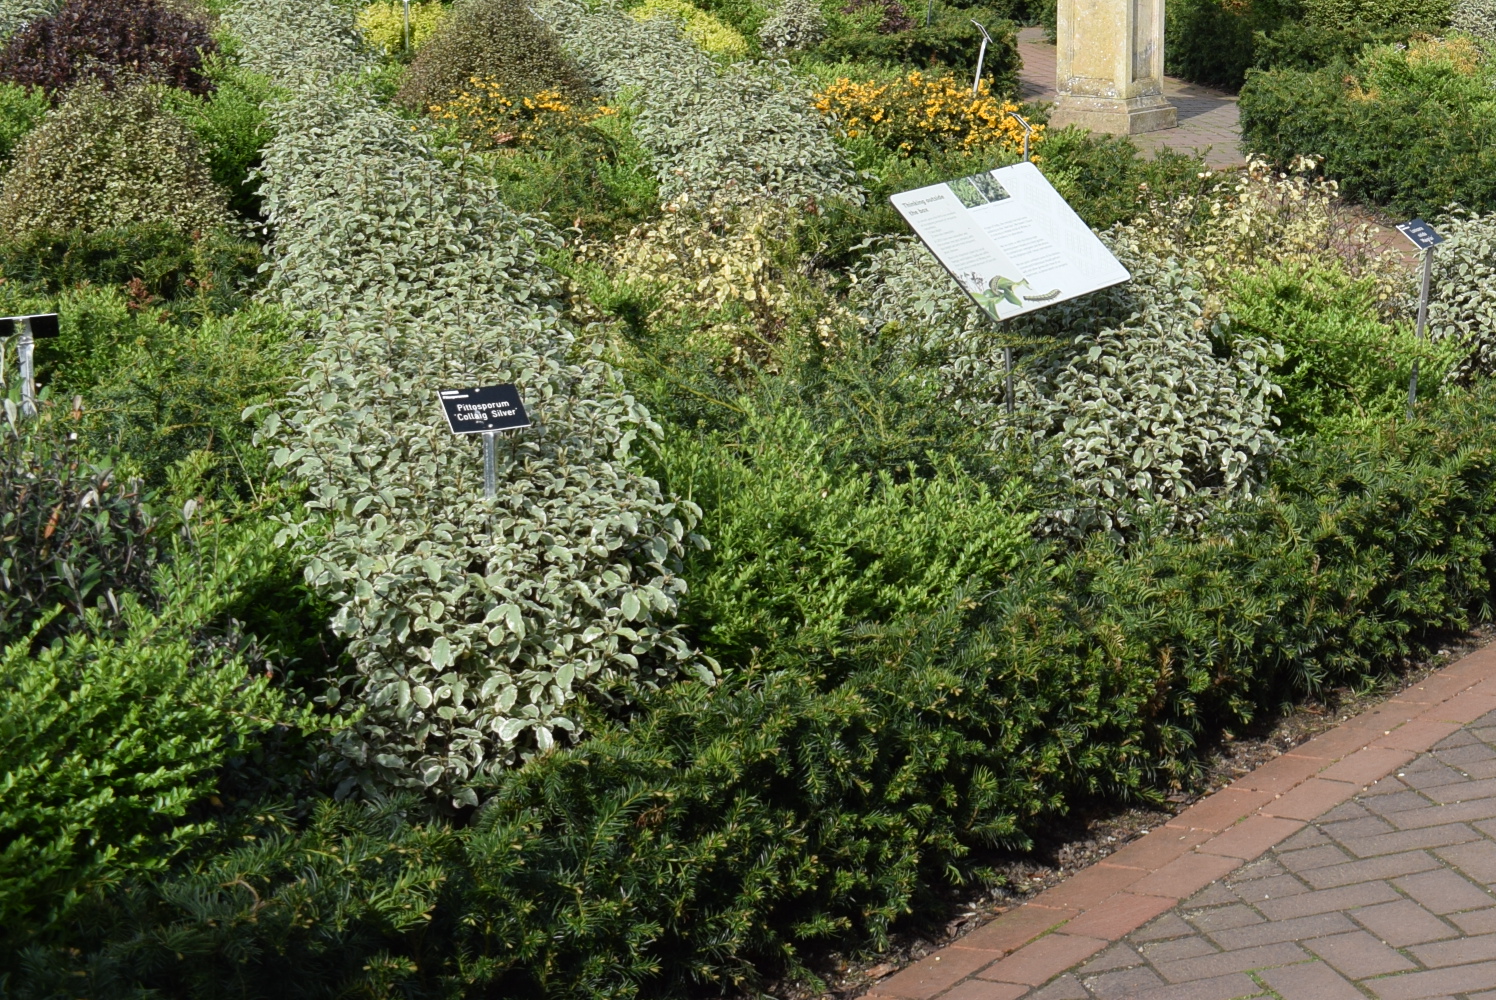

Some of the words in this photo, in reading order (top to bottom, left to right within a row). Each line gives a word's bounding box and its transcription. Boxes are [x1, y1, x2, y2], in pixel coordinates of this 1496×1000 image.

[902, 199, 927, 208] Thinking
[926, 194, 945, 203] outside
[456, 400, 510, 412] Pittosporum
